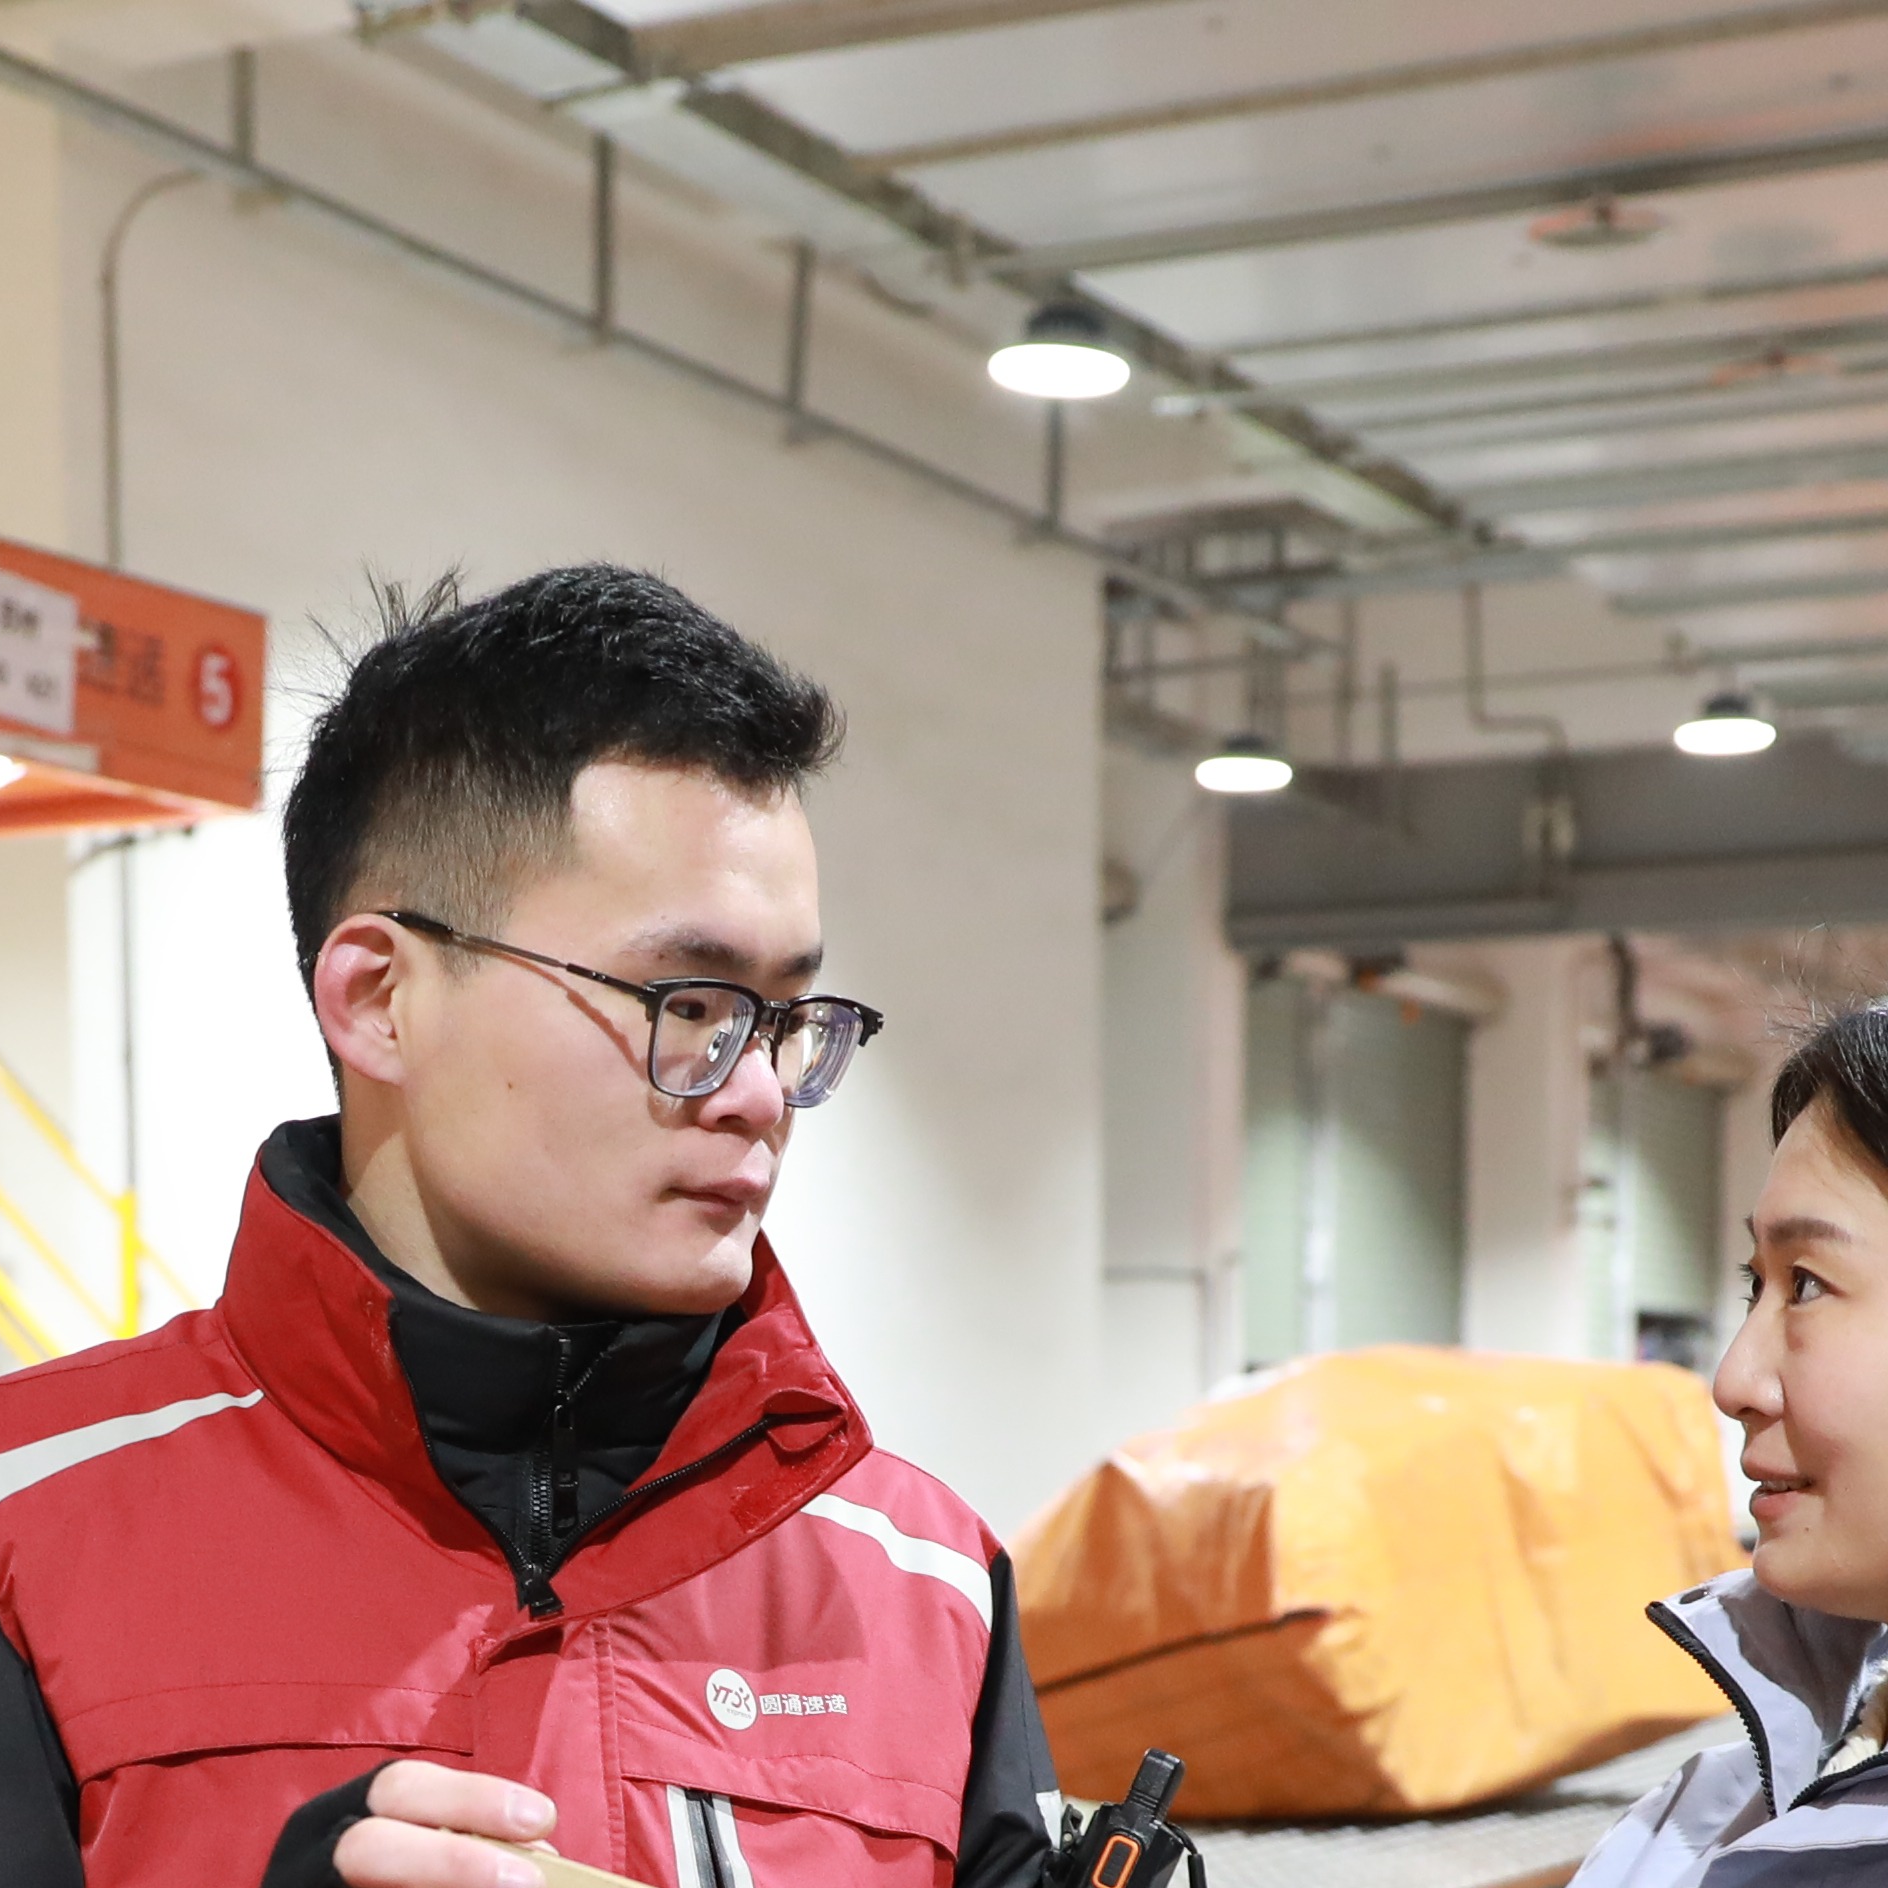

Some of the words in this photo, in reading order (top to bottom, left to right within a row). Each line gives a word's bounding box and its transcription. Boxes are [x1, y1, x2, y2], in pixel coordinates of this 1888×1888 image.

[198, 650, 234, 726] 5
[759, 1694, 848, 1716] 圆通速递
